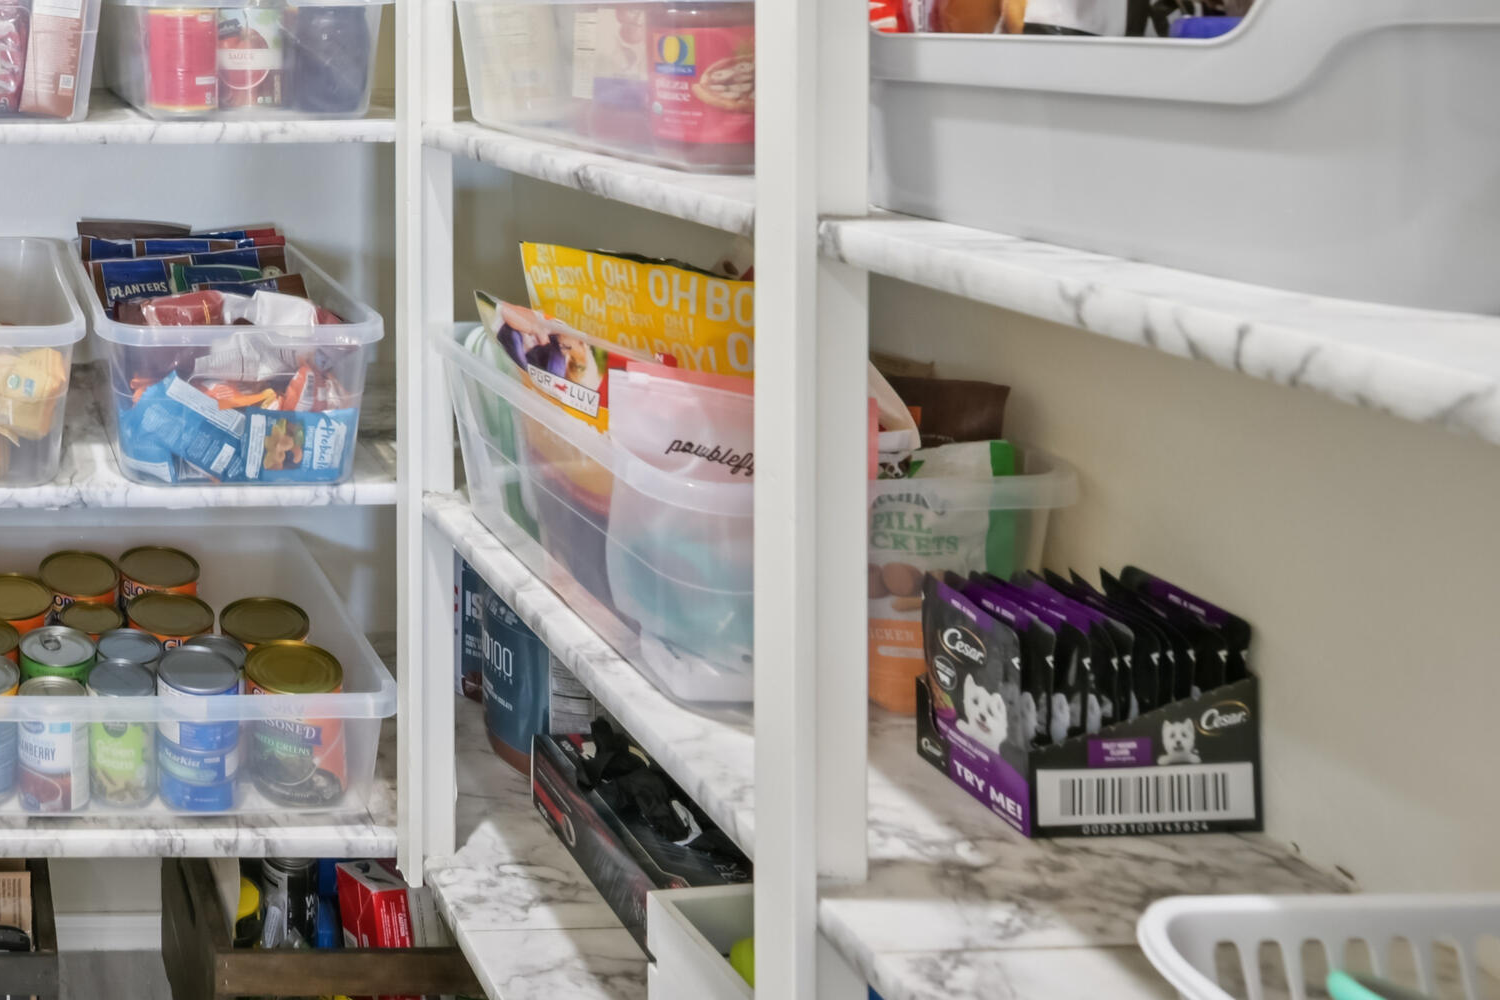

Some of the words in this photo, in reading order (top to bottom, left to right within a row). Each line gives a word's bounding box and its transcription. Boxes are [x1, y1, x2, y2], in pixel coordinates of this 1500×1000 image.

[109, 281, 168, 299] PLANTERS
[648, 268, 698, 316] OH
[705, 281, 754, 327] BO
[583, 292, 607, 321] OH
[569, 386, 597, 405] LUV
[872, 511, 933, 534] PILL
[870, 531, 960, 556] CKETS
[942, 627, 984, 663] Cesar
[1200, 707, 1249, 731] Cesar
[19, 738, 56, 762] ANBERRY
[164, 747, 201, 768] StarKist
[952, 759, 987, 793] TRY
[988, 785, 1024, 821] ME!
